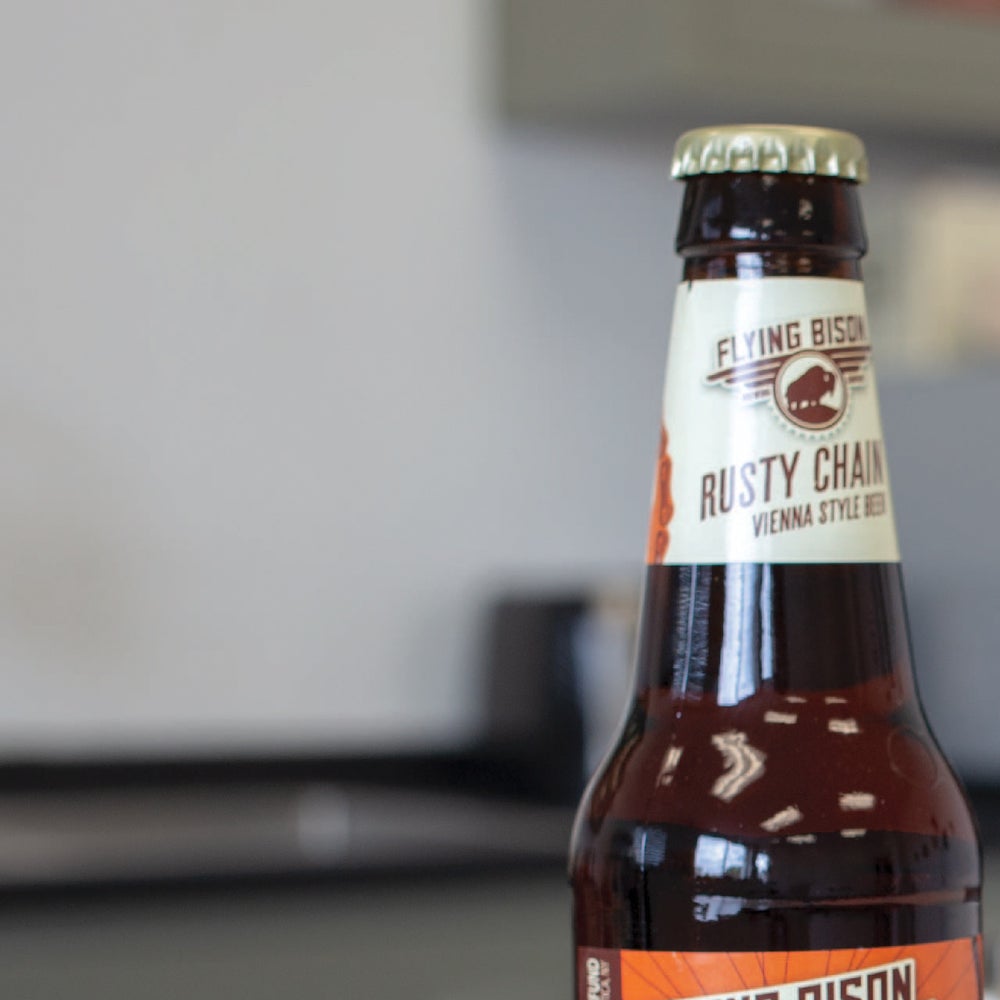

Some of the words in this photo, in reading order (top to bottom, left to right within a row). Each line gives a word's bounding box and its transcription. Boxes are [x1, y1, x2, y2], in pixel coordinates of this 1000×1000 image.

[717, 321, 800, 367] FLYING
[701, 451, 800, 521] RUSTY
[814, 440, 883, 493] CHAIN
[753, 502, 814, 538] VIENNA
[819, 495, 860, 525] STYLE
